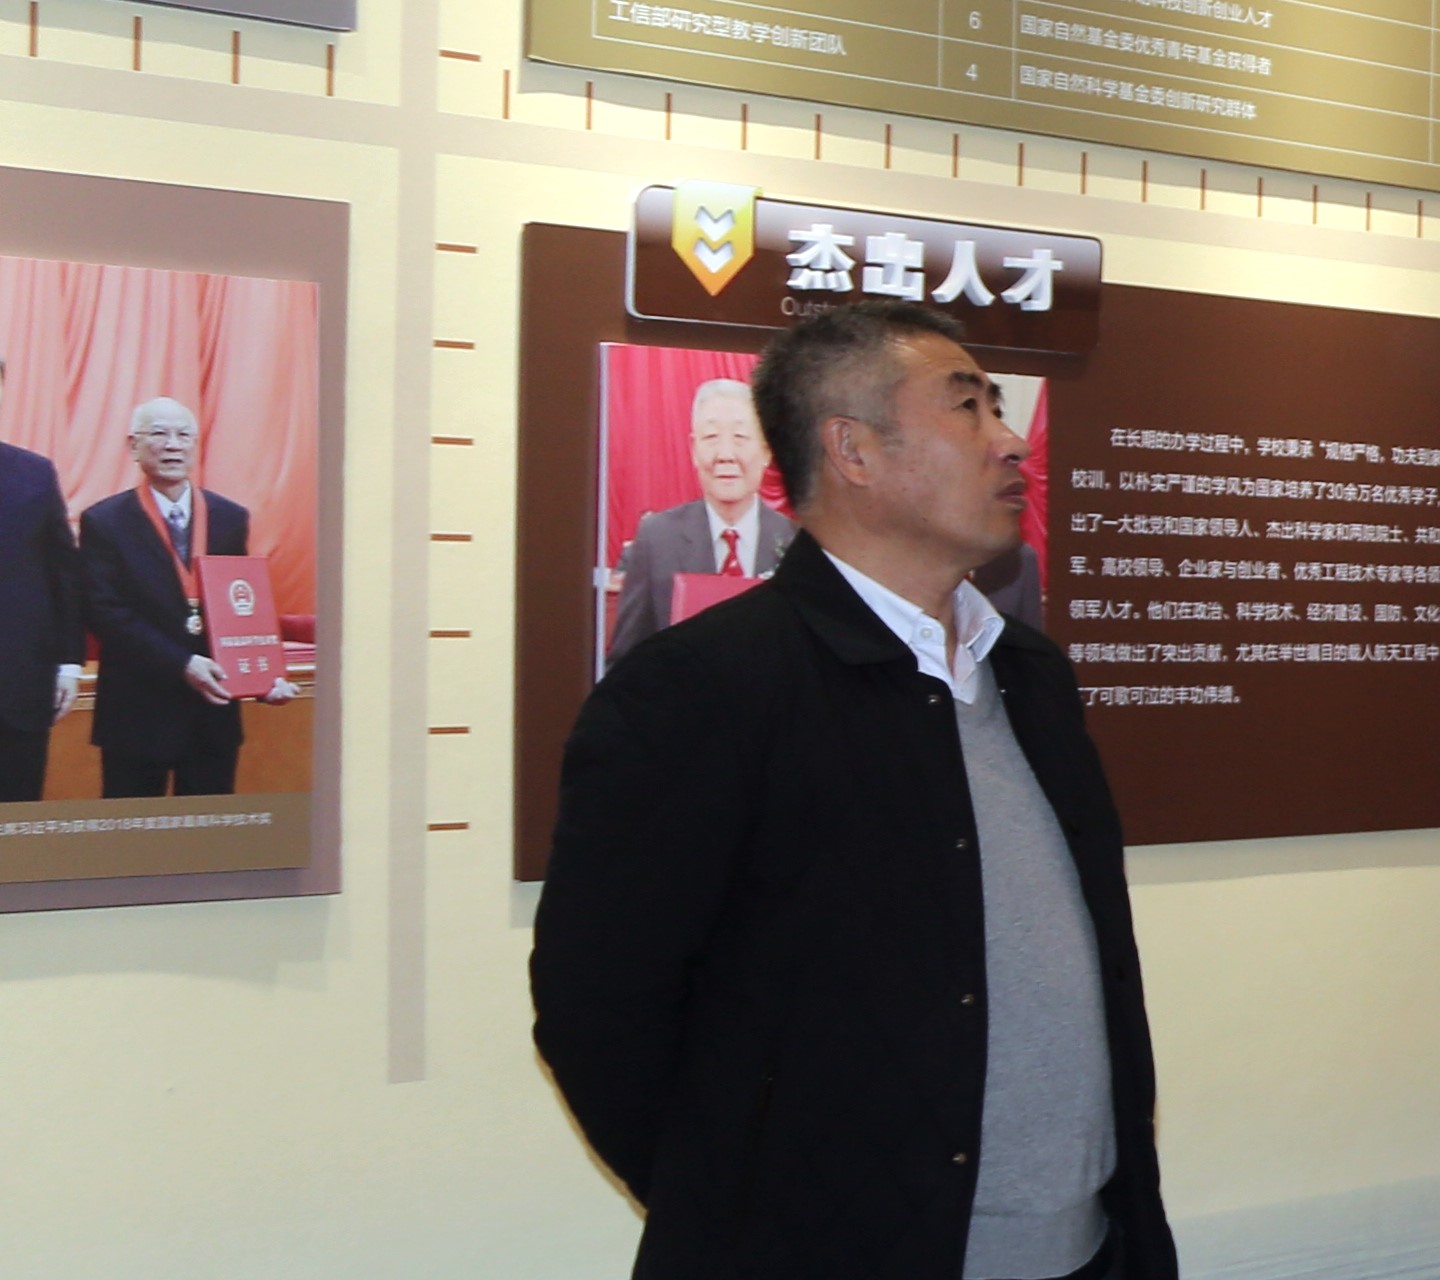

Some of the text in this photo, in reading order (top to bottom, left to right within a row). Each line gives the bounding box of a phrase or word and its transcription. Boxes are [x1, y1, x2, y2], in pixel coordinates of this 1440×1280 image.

[609, 0, 848, 56] 工信部研究型教学创新团队
[966, 63, 979, 82] 4
[1019, 64, 1258, 121] 国家自然科学基金委创新研究群体
[968, 11, 982, 30] 6
[1020, 13, 1273, 76] 国家自然基金委优秀青年基金获得者
[786, 223, 1063, 312] 杰出人才
